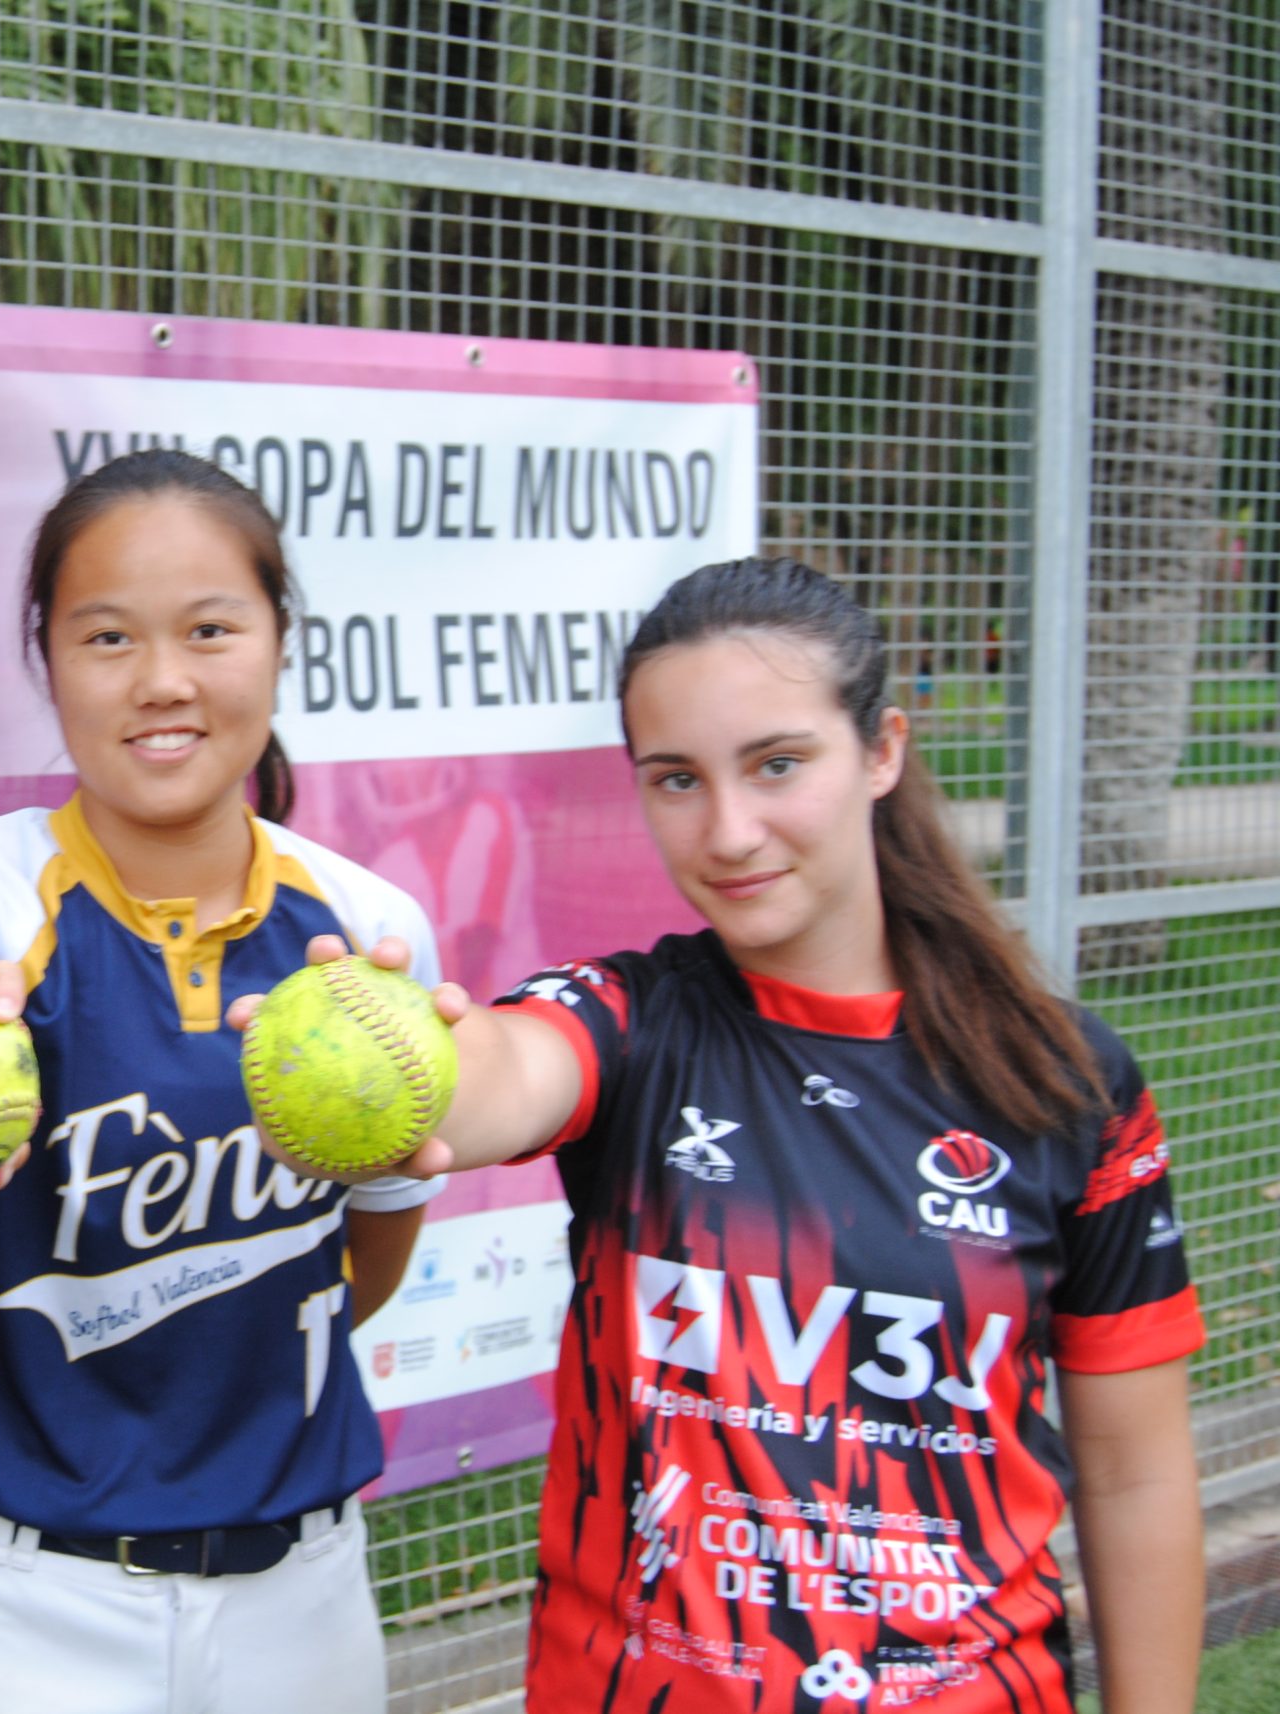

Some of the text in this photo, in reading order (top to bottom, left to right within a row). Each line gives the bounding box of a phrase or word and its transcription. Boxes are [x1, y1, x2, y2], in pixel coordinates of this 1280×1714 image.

[395, 442, 494, 538] DEL
[512, 446, 715, 539] MUNDO
[434, 610, 646, 708] FEMEN
[918, 1191, 1009, 1237] CAU
[746, 1274, 1012, 1412] V3J
[630, 1376, 998, 1456] Ingeniería y servicios
[702, 1482, 961, 1535] Comunitat Valenciana
[699, 1514, 961, 1578] COMUNITAT
[715, 1561, 777, 1606] DE
